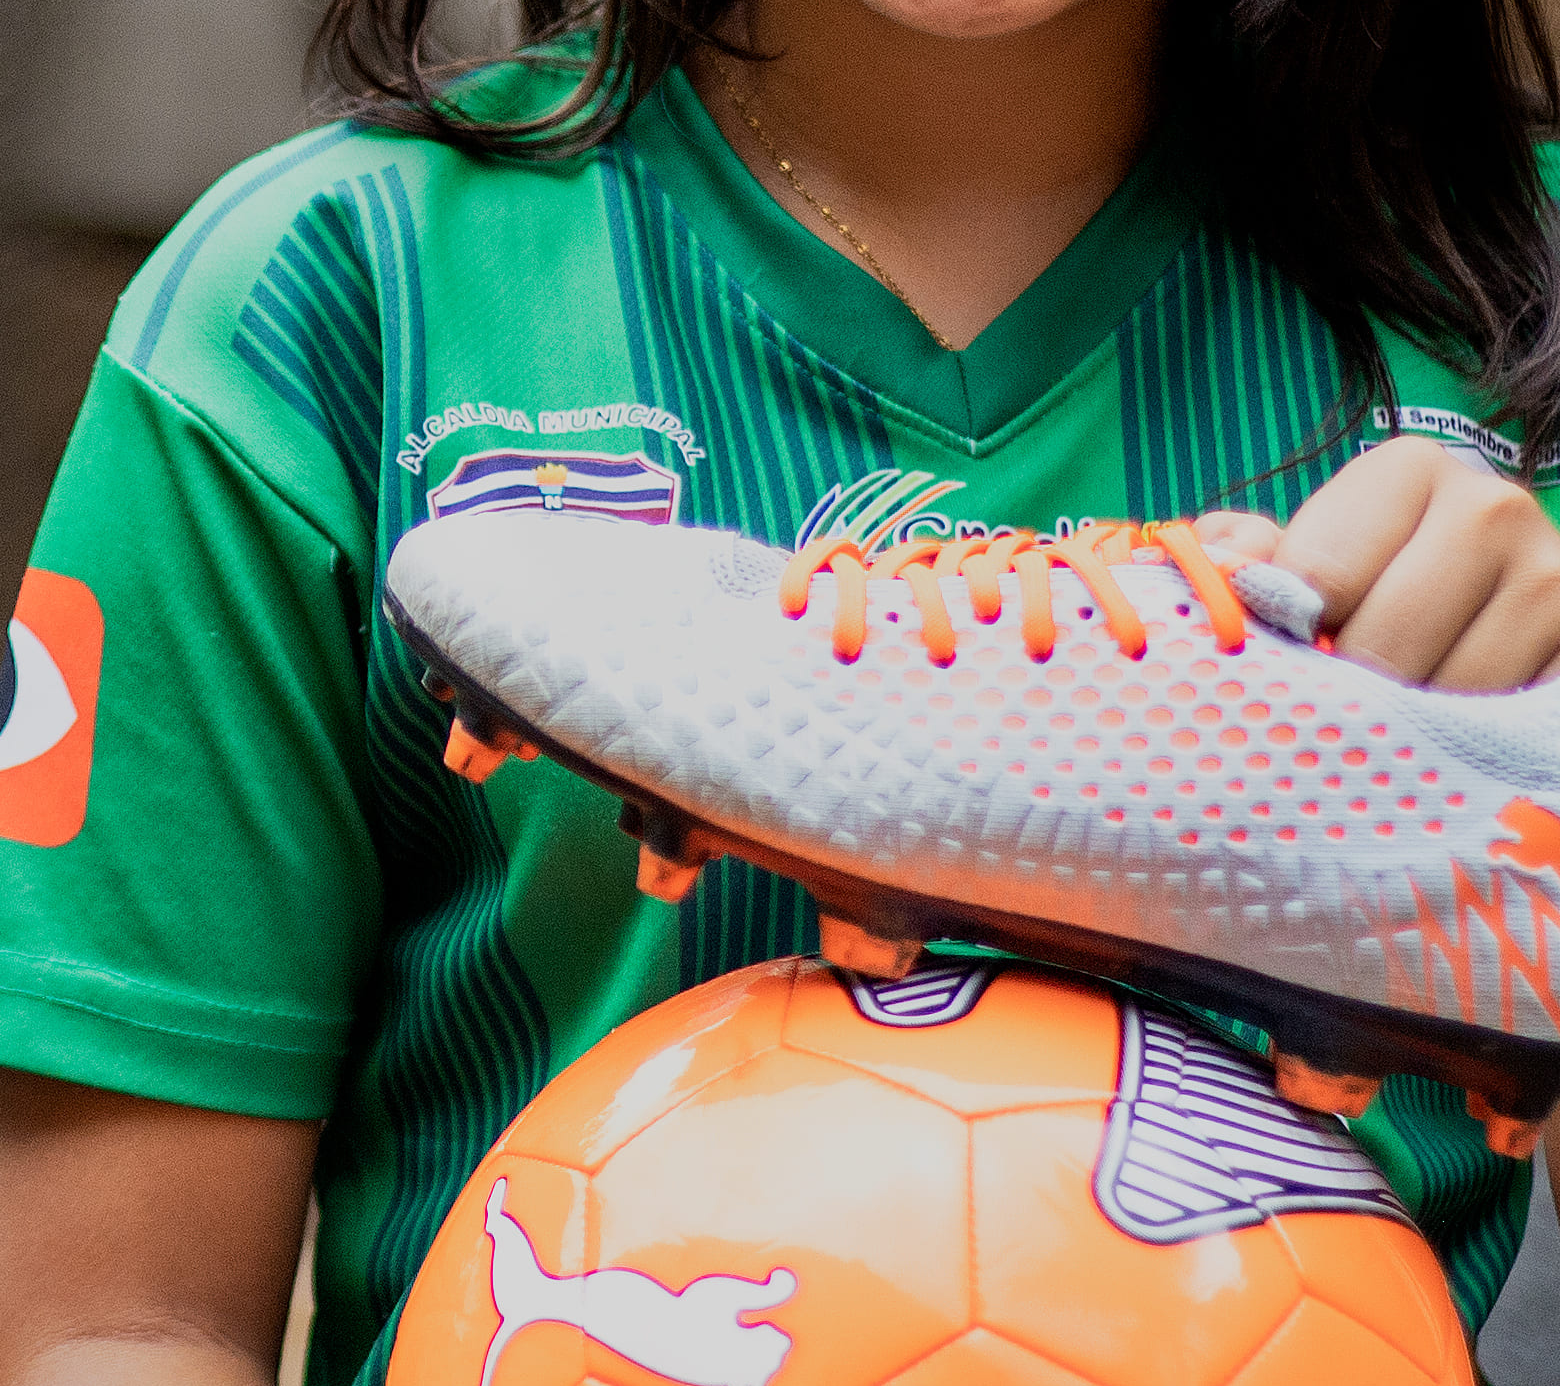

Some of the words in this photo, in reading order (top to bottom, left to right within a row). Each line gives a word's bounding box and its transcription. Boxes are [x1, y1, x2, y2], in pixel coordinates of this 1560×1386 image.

[396, 402, 533, 475] ALCALDIA
[538, 402, 706, 466] MUNICIPAL
[1409, 408, 1515, 463] Septiembre
